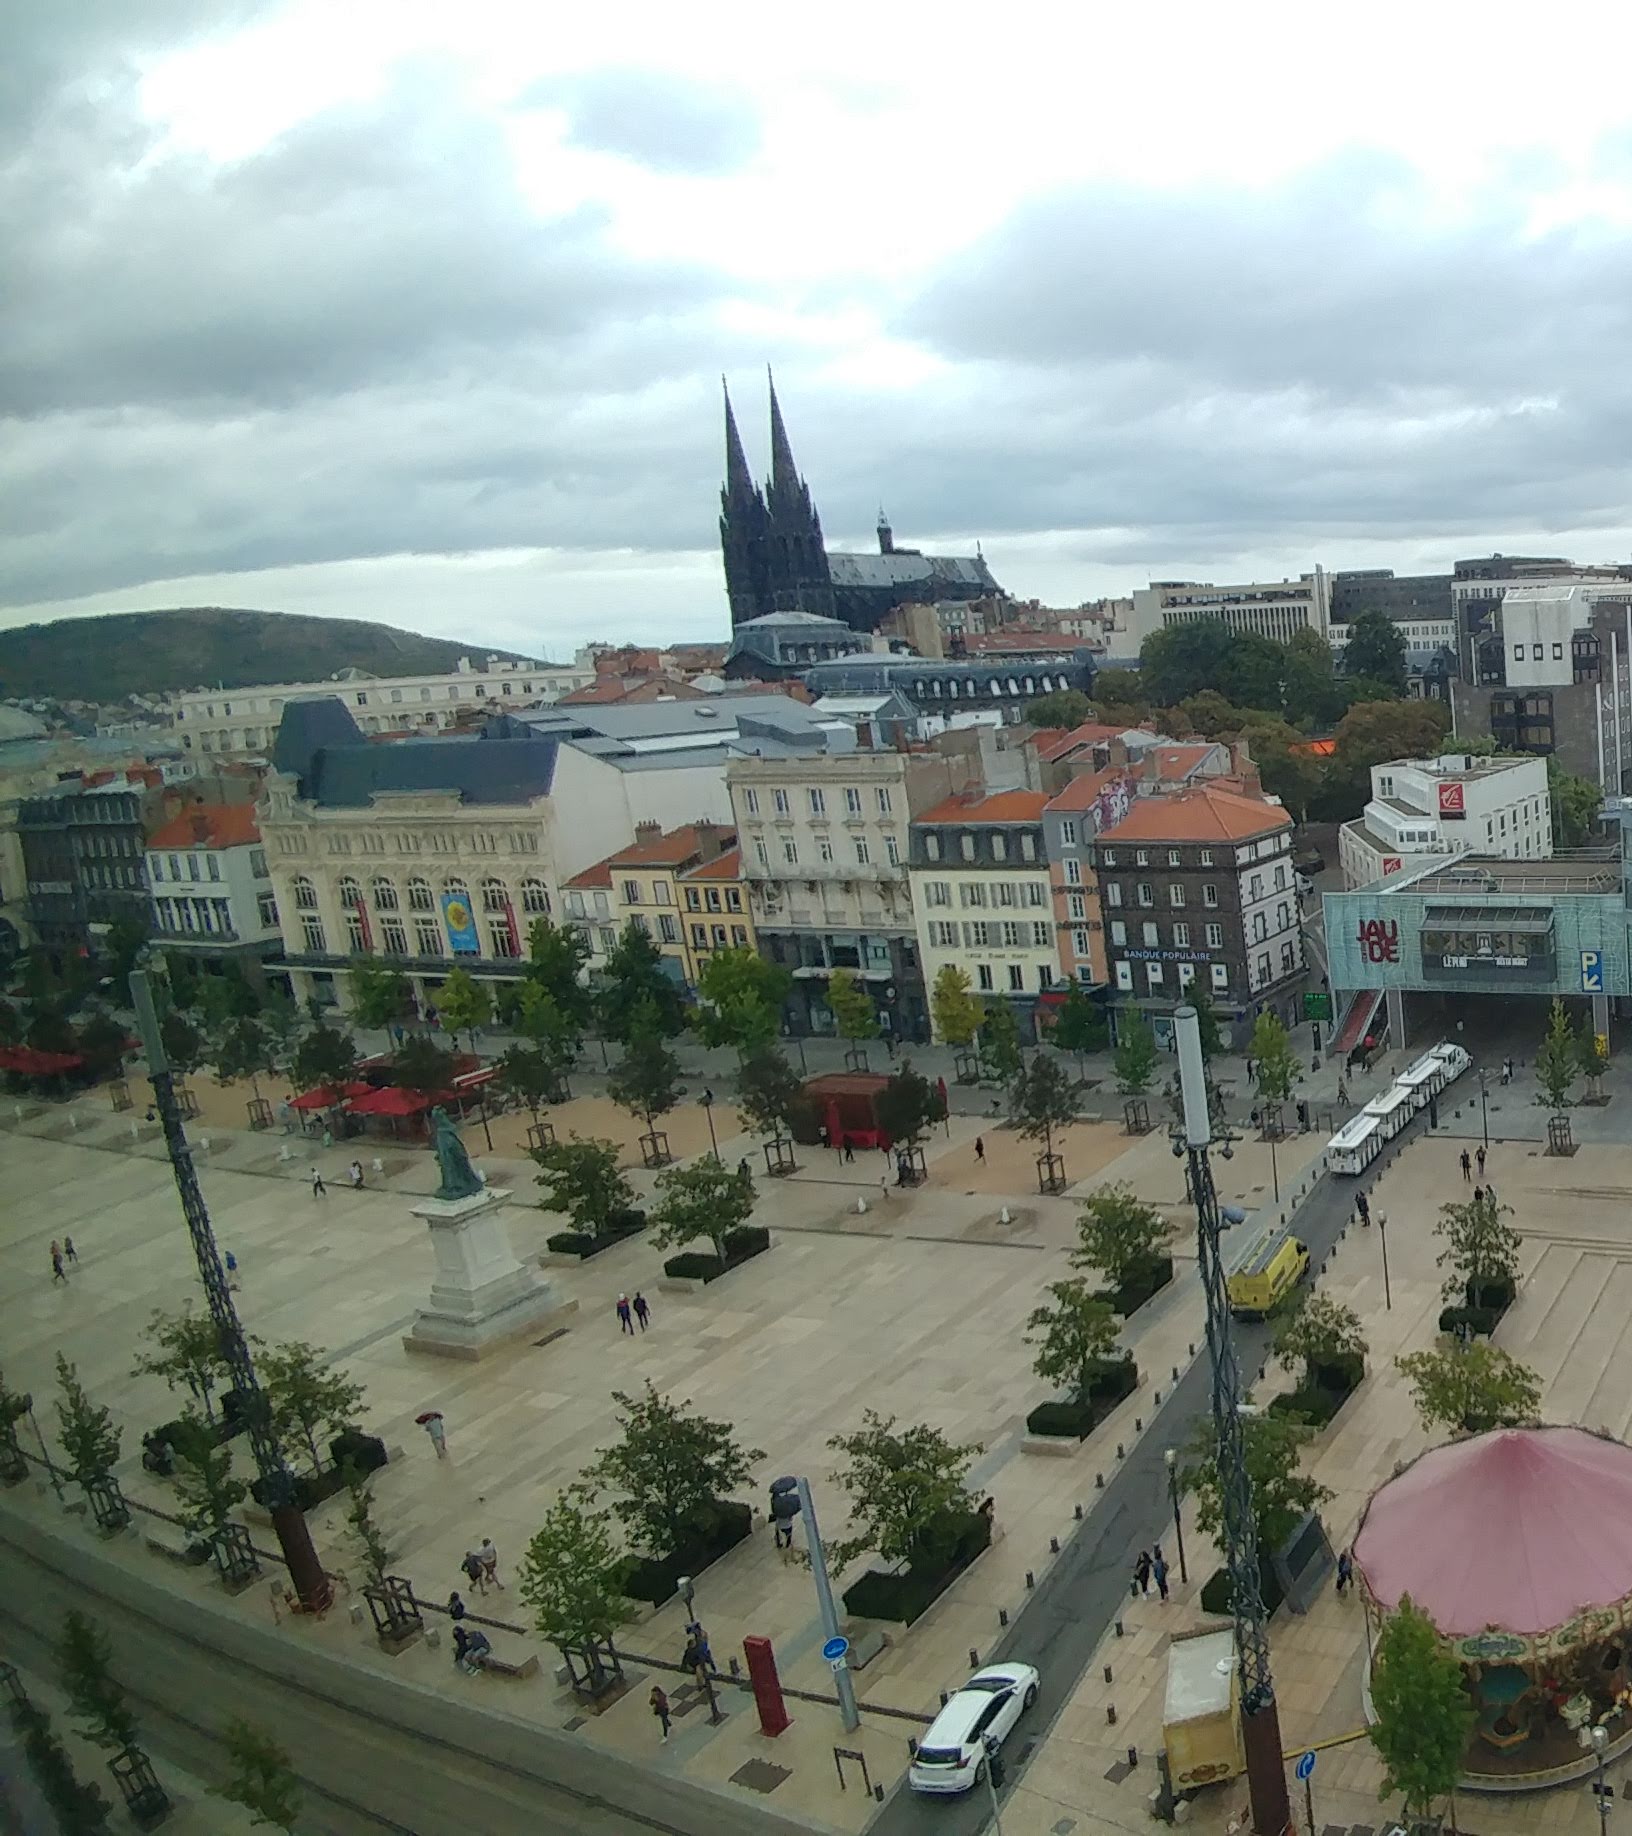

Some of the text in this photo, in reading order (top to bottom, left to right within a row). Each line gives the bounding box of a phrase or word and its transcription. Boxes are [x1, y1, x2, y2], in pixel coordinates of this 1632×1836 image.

[1124, 951, 1211, 961] BANQUE POPULAIRE
[1581, 952, 1598, 971] P
